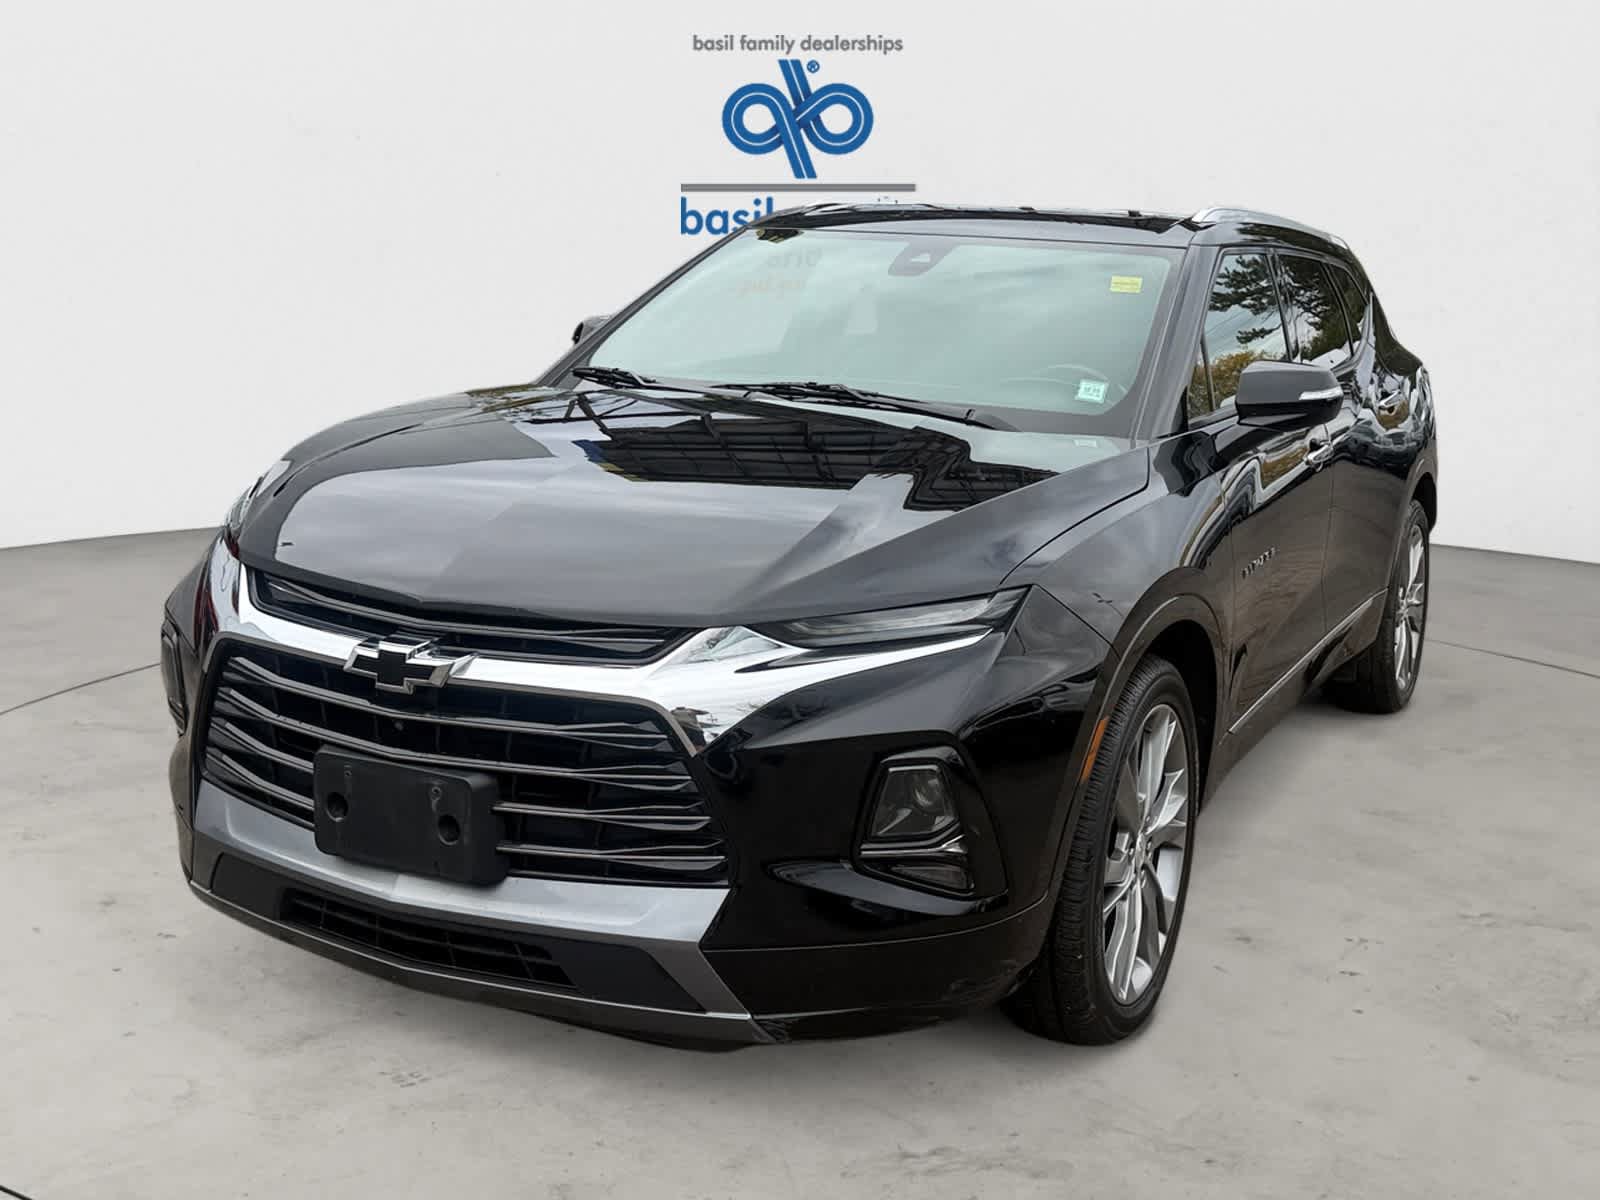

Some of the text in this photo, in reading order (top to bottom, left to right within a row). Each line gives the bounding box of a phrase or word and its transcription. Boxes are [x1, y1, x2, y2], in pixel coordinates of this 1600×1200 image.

[692, 34, 904, 56] basil family dealerships
